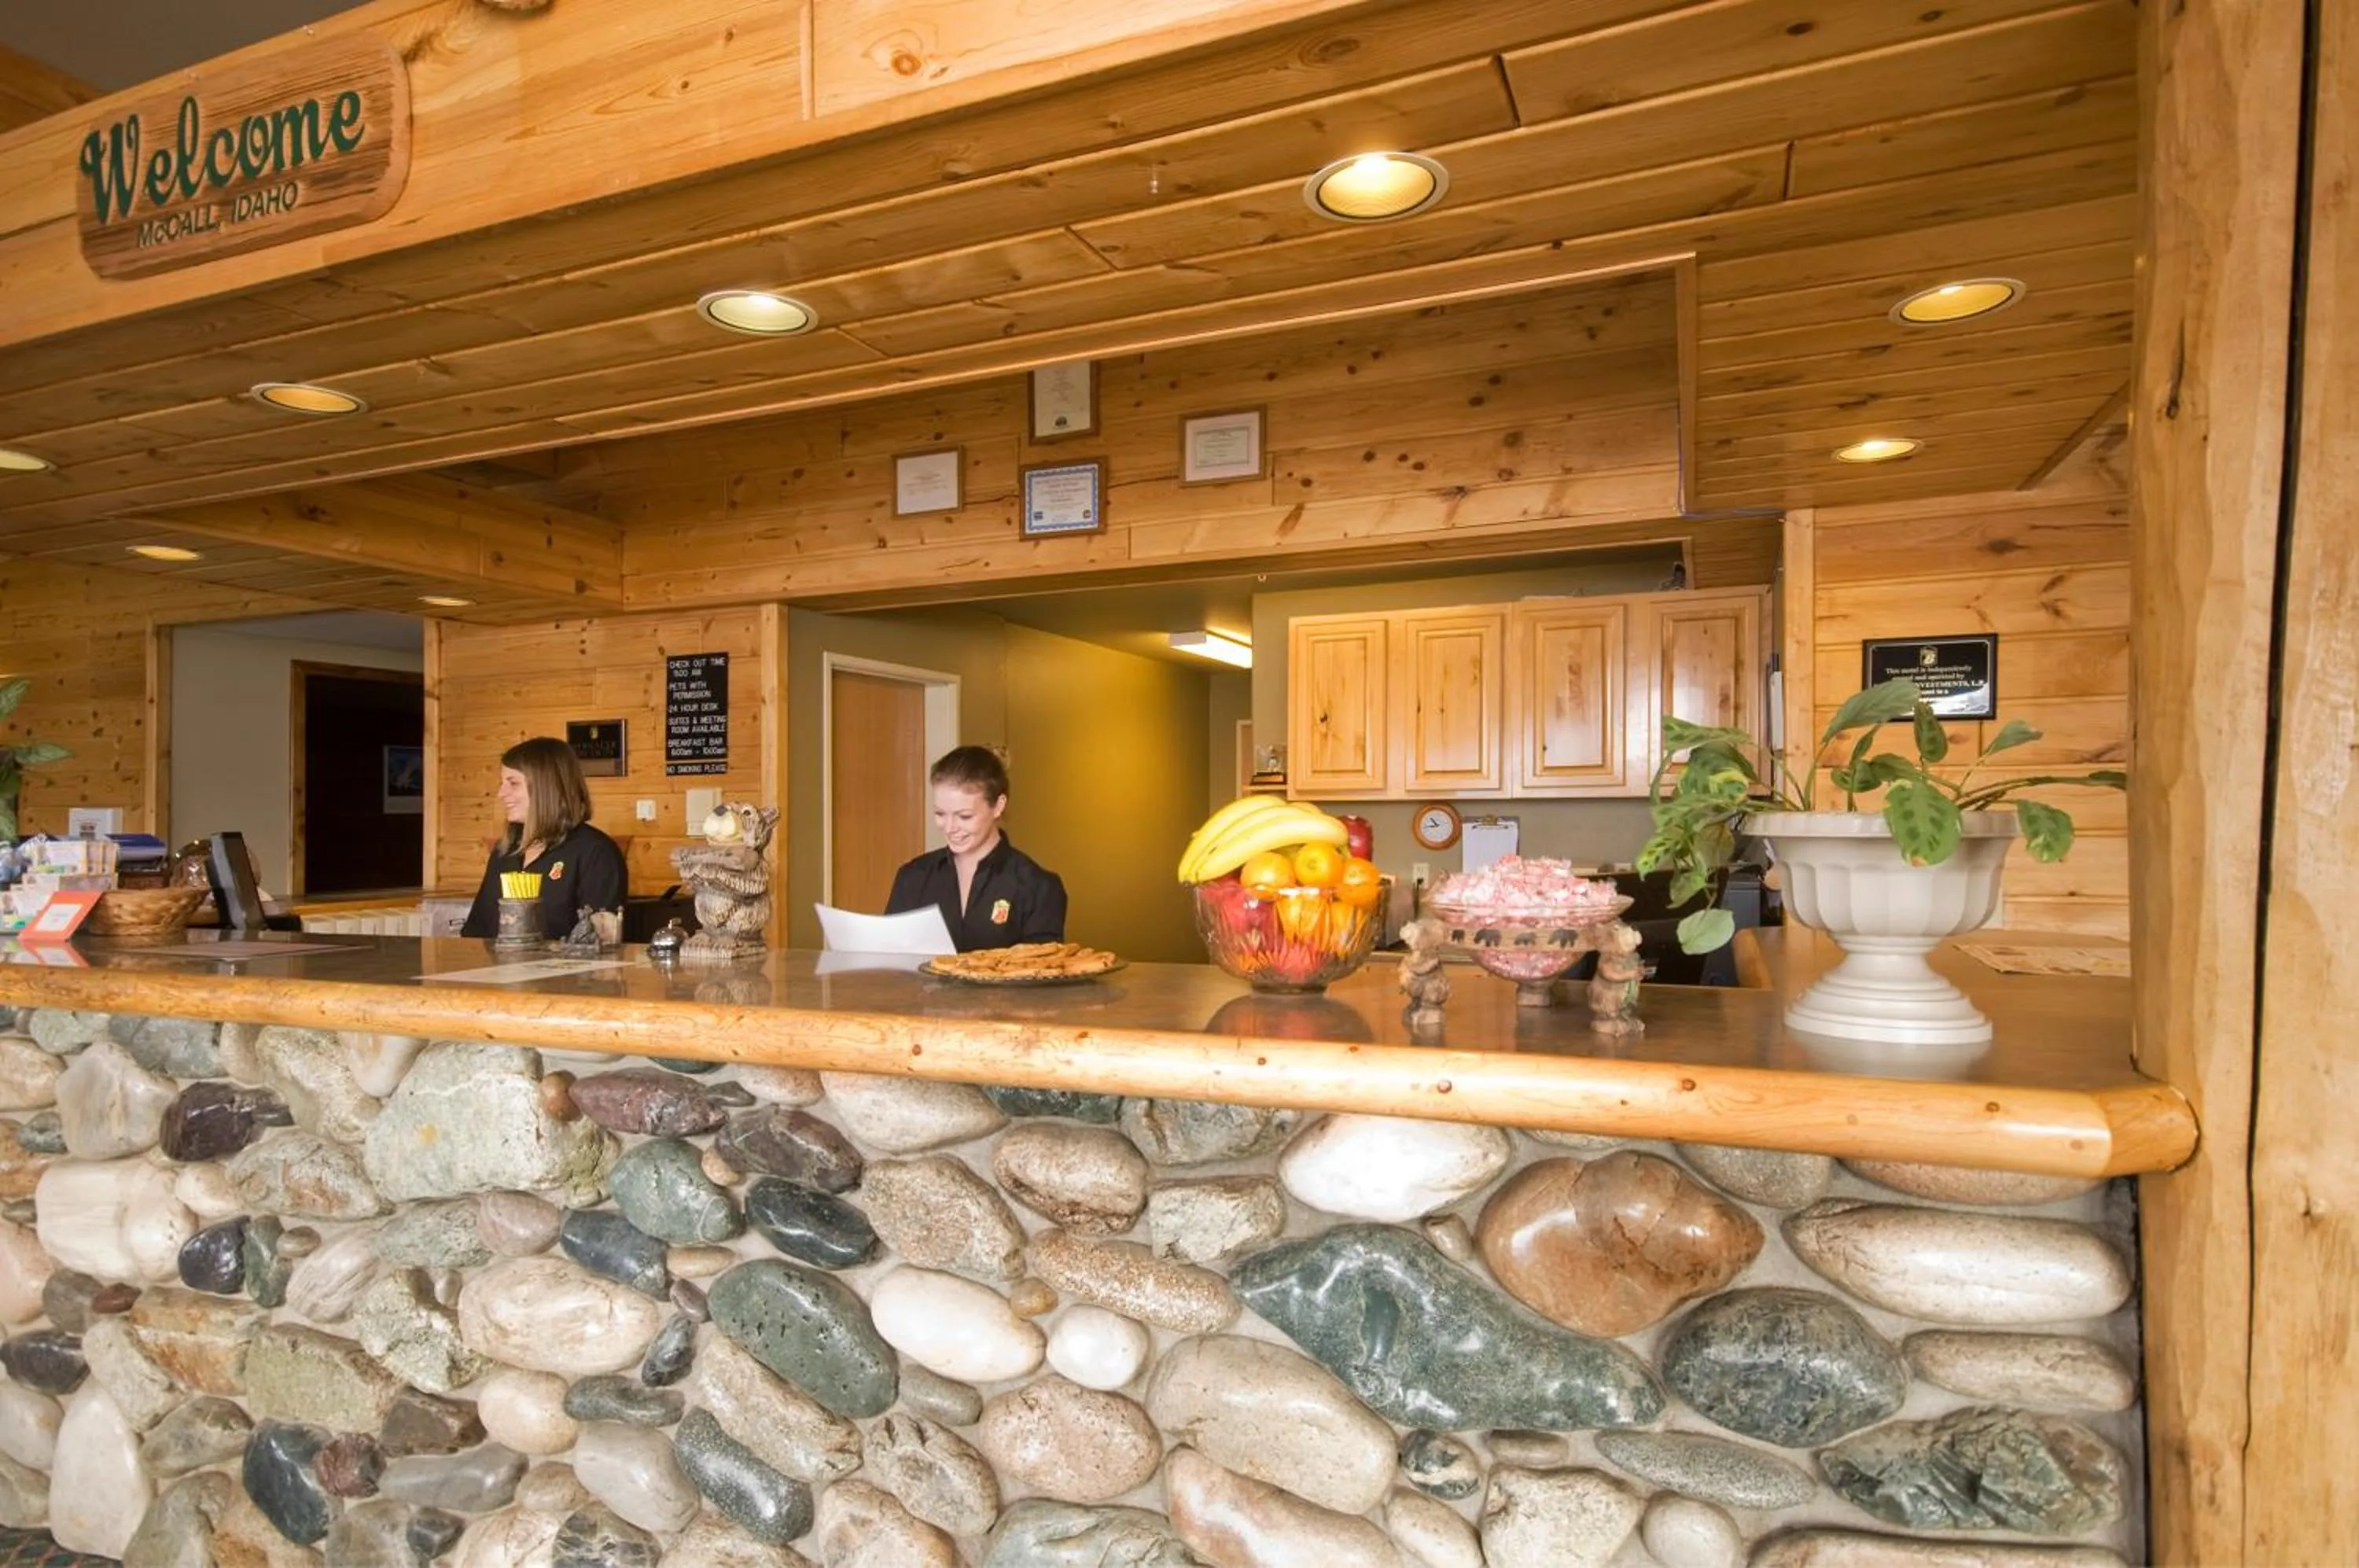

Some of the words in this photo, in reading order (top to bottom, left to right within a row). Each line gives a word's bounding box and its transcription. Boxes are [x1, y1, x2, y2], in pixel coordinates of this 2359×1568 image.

[79, 90, 366, 226] Welcome
[230, 182, 299, 224] IDAHO
[669, 660, 690, 668] CHECK
[693, 659, 706, 668] OUT
[710, 657, 725, 666] TIME
[670, 682, 686, 690] PETS
[673, 690, 712, 699] PERMISSION
[668, 704, 678, 712] 24
[681, 703, 699, 712] HOUR
[701, 702, 719, 711] DESK
[669, 717, 690, 726] SUITES
[700, 715, 727, 724] MEETING
[692, 724, 725, 733] AVAILABLE
[668, 738, 706, 748] BREAKFAST
